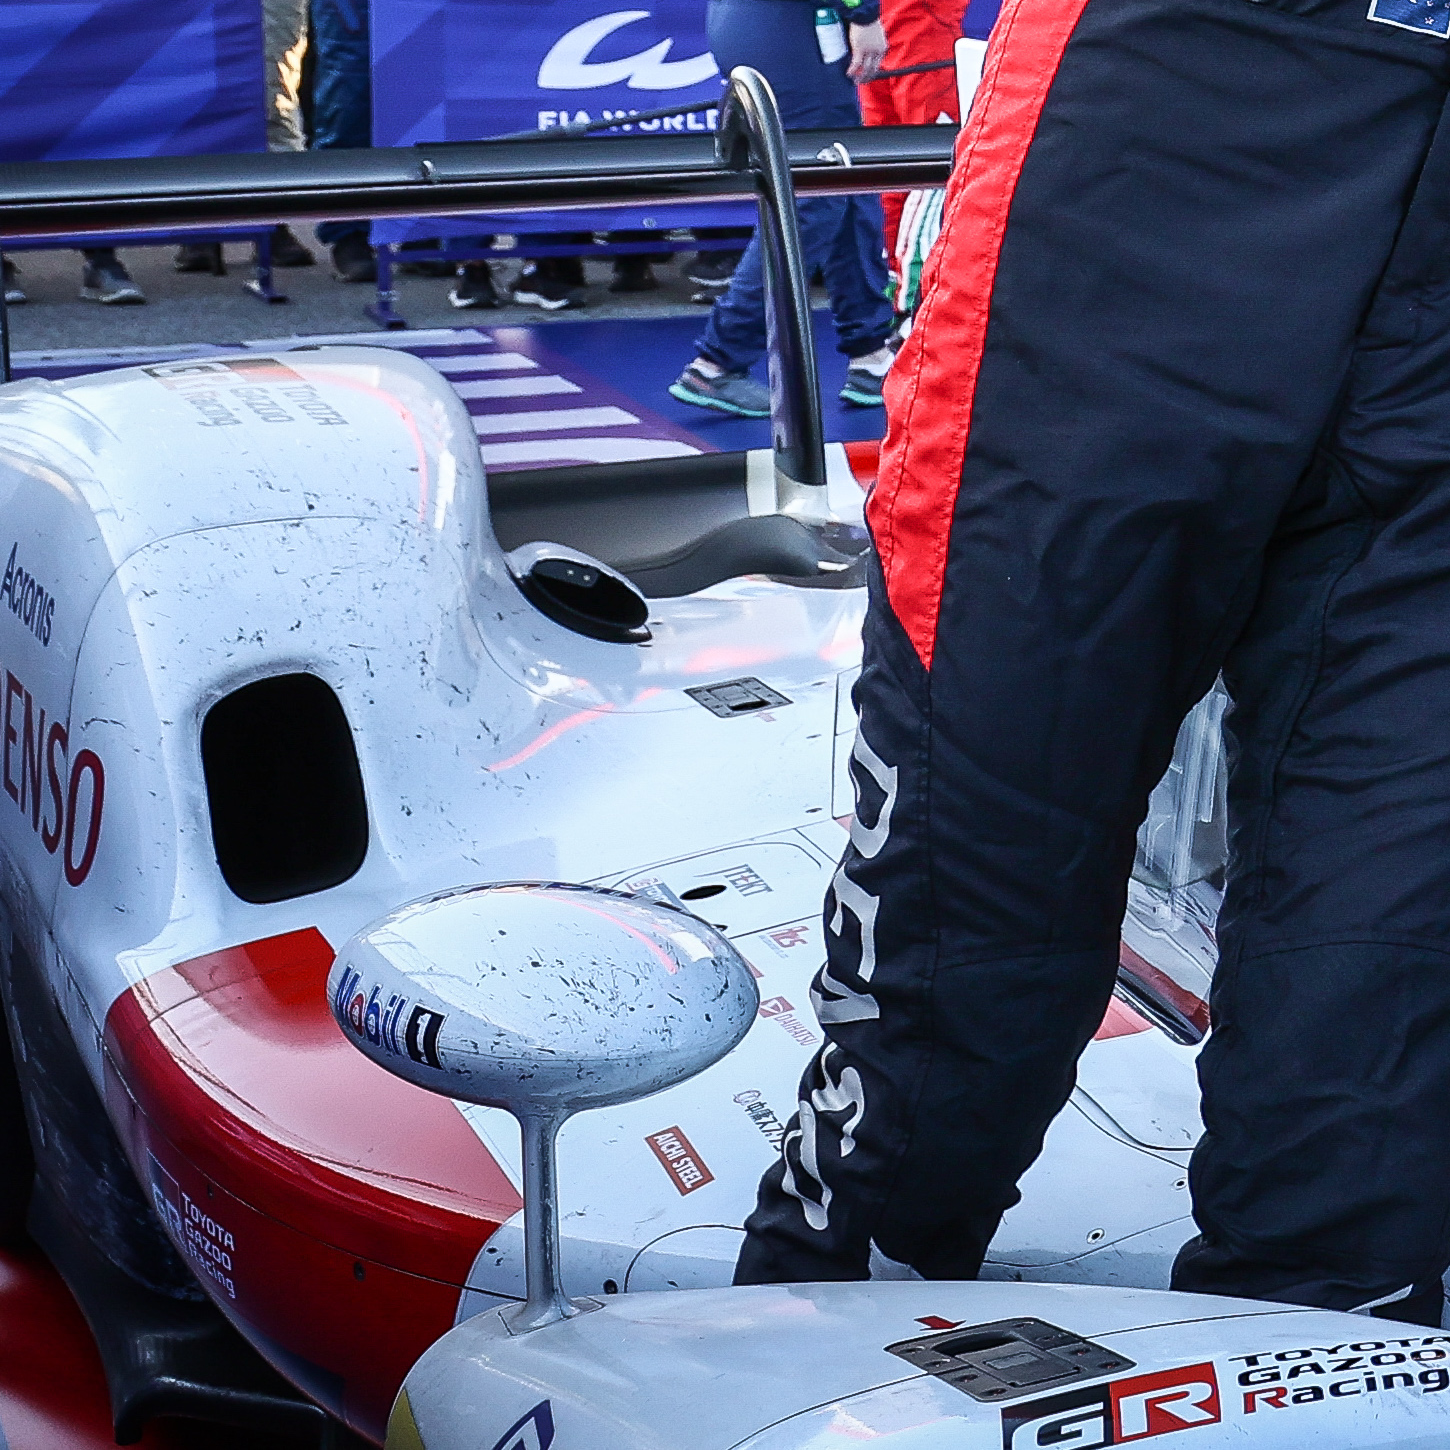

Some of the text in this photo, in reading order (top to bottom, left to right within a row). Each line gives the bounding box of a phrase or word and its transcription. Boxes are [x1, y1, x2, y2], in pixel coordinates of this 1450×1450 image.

[537, 110, 592, 132] FIA
[276, 383, 350, 426] TOYOTA
[1, 541, 55, 648] Acronis
[336, 965, 409, 1056] Mobil
[773, 1012, 819, 1046] DAIHATSU
[653, 1132, 704, 1189] AICHI STEEL
[181, 1191, 235, 1252] TOYOTA
[184, 1217, 232, 1271] GAZOO
[187, 1238, 236, 1299] Racing
[1238, 1348, 1449, 1387] GAZOO
[1243, 1367, 1450, 1414] Racing
[1010, 1380, 1218, 1450] GR
